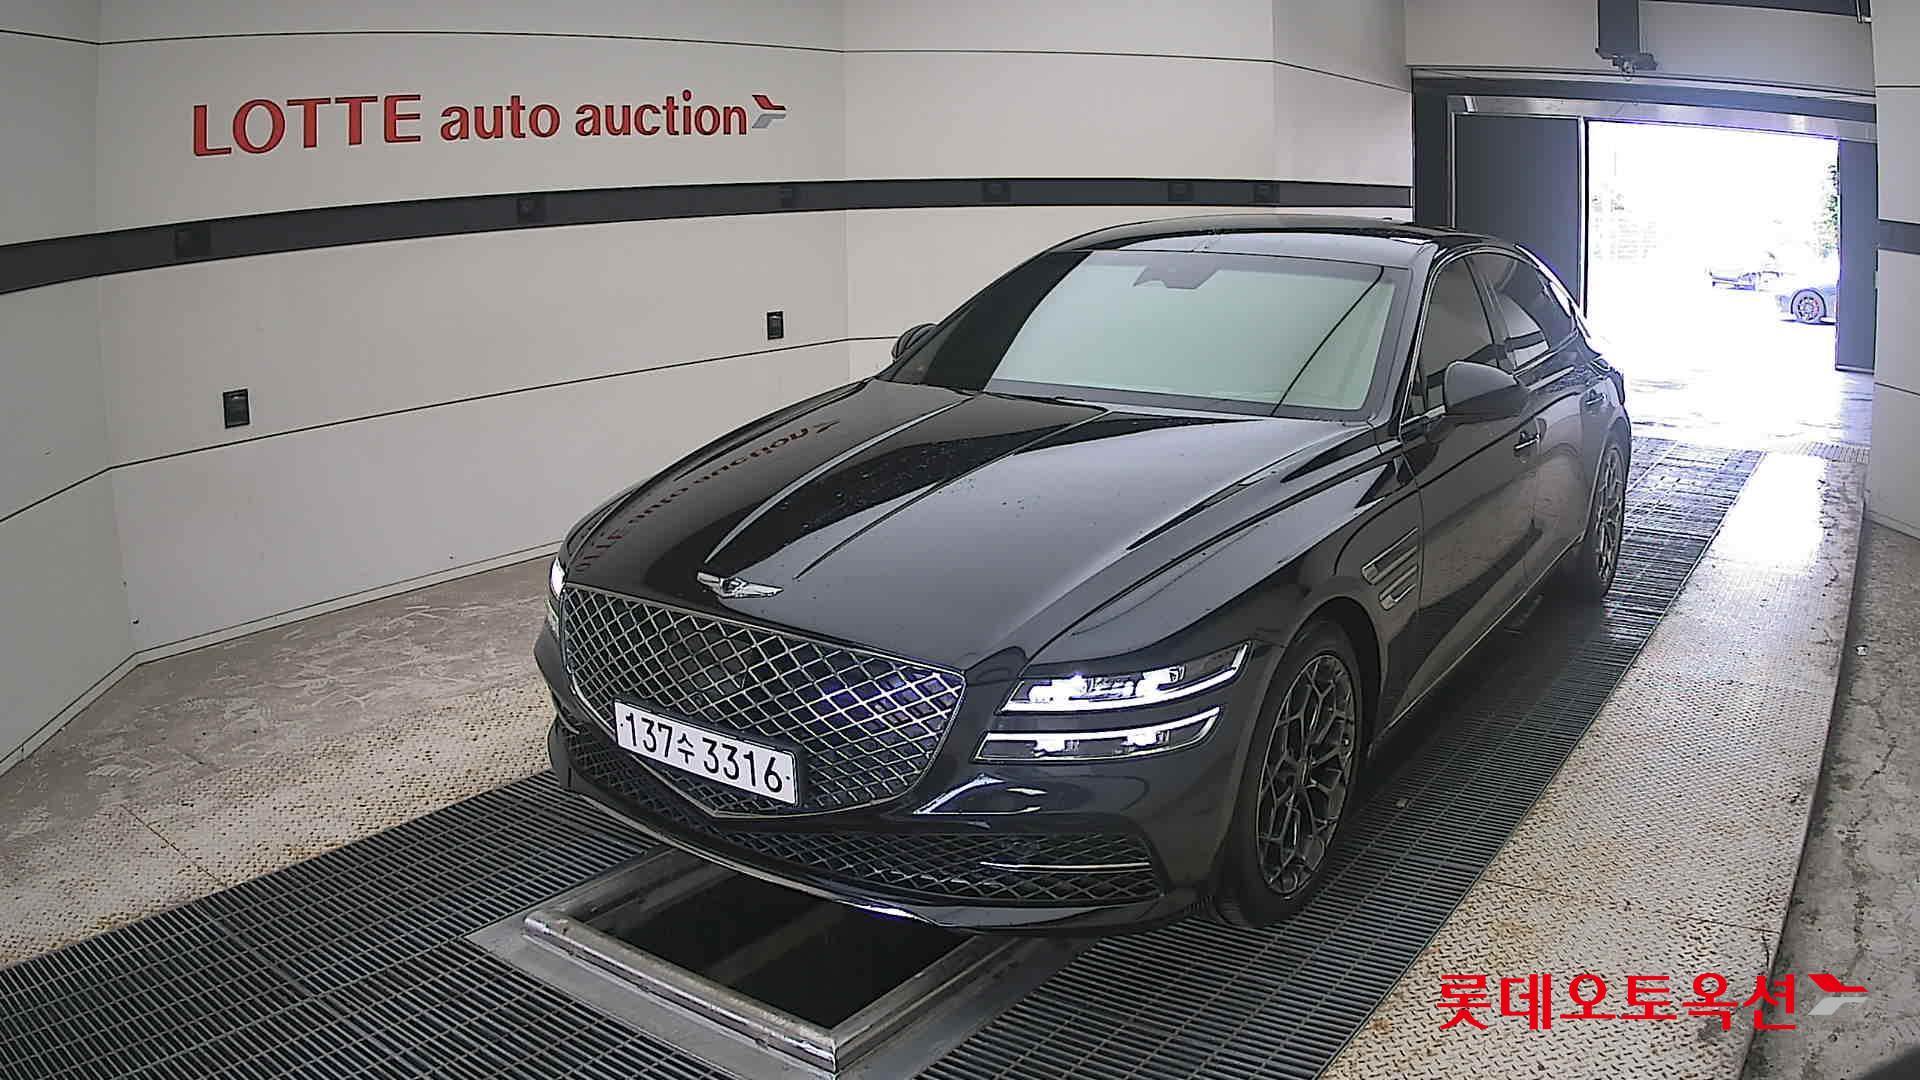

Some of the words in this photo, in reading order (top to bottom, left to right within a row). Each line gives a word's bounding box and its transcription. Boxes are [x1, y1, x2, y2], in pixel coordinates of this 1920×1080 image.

[193, 94, 421, 157] LOTTE
[440, 95, 561, 141] auto
[575, 89, 749, 137] auction
